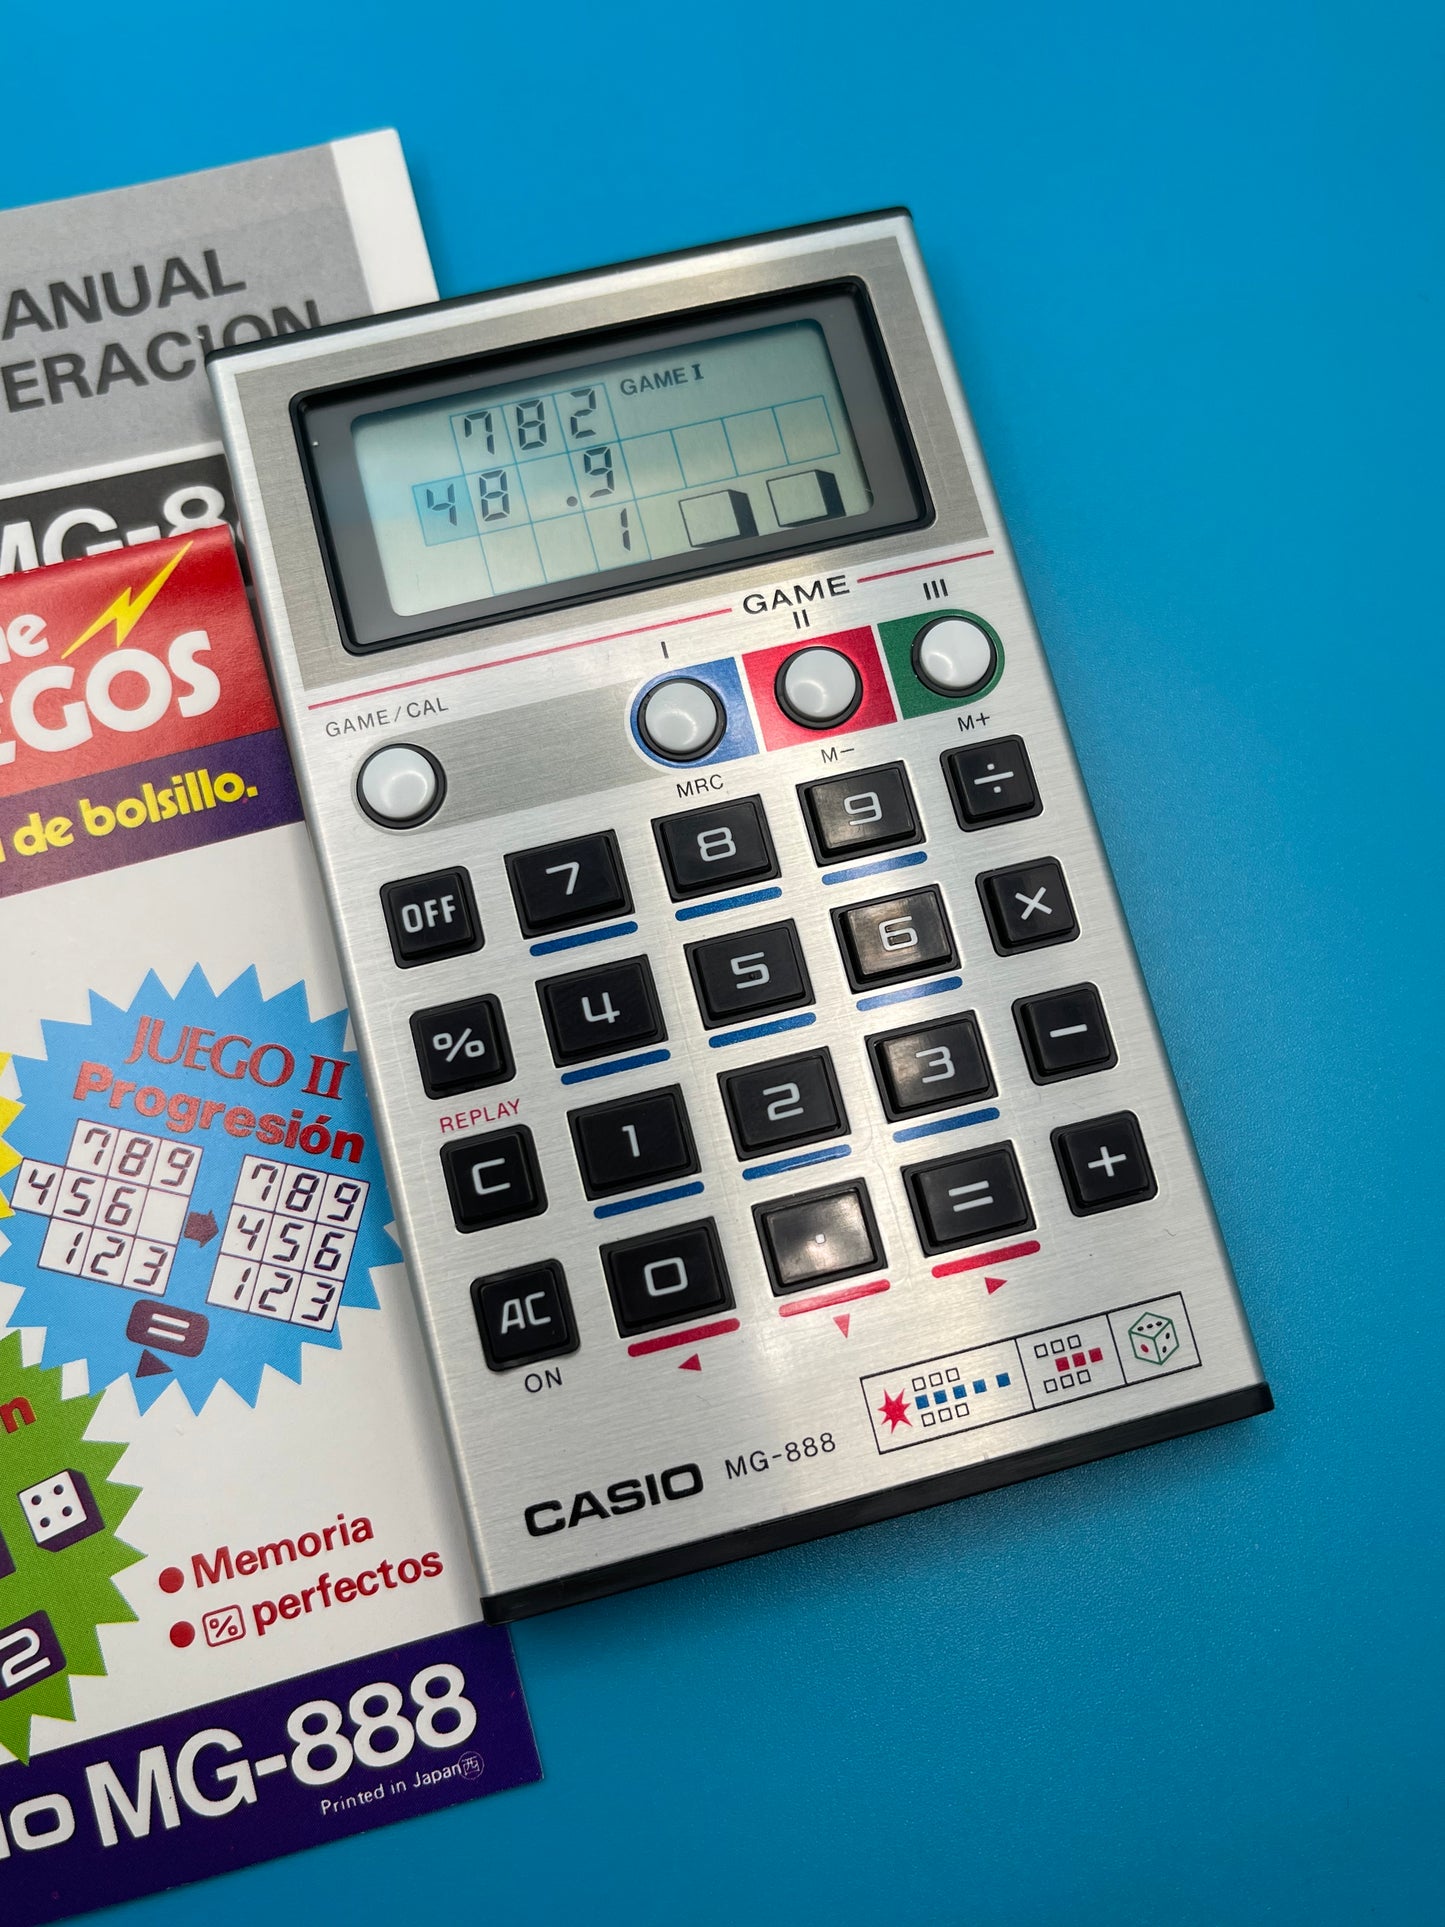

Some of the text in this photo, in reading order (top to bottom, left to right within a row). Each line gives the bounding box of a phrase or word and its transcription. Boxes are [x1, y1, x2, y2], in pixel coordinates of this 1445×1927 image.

[1, 249, 247, 341] ANUAL
[620, 368, 688, 396] GAME
[743, 575, 850, 615] GAME
[923, 578, 949, 601] III
[325, 697, 449, 738] GAME/CAL
[957, 713, 990, 732] M+
[676, 775, 724, 799] MRC
[13, 813, 75, 856] de
[79, 768, 259, 836] bolsillo.
[843, 791, 883, 826] 9
[697, 826, 737, 862] 8
[545, 861, 580, 896] 7
[401, 895, 456, 934] OFF
[878, 916, 919, 951] 6
[730, 951, 770, 989] 5
[581, 991, 620, 1024] 4
[125, 1015, 351, 1100] JUEGO II
[432, 1028, 486, 1062] %
[915, 1045, 956, 1083] 3
[72, 1061, 365, 1164] Progresión
[439, 1099, 521, 1133] REPLAY
[763, 1082, 804, 1122] 2
[621, 1124, 642, 1158] 1
[471, 1157, 511, 1196] C
[643, 1256, 688, 1297] 0
[500, 1291, 551, 1334] AC
[523, 1366, 563, 1394] ON
[524, 1432, 837, 1537] CASIO MG-888
[190, 1512, 375, 1589] Memoria
[253, 1550, 444, 1635] perfectos
[0, 1628, 51, 1688] 2
[85, 1663, 478, 1847] MG-888
[320, 1763, 462, 1815] Printed in Japan
